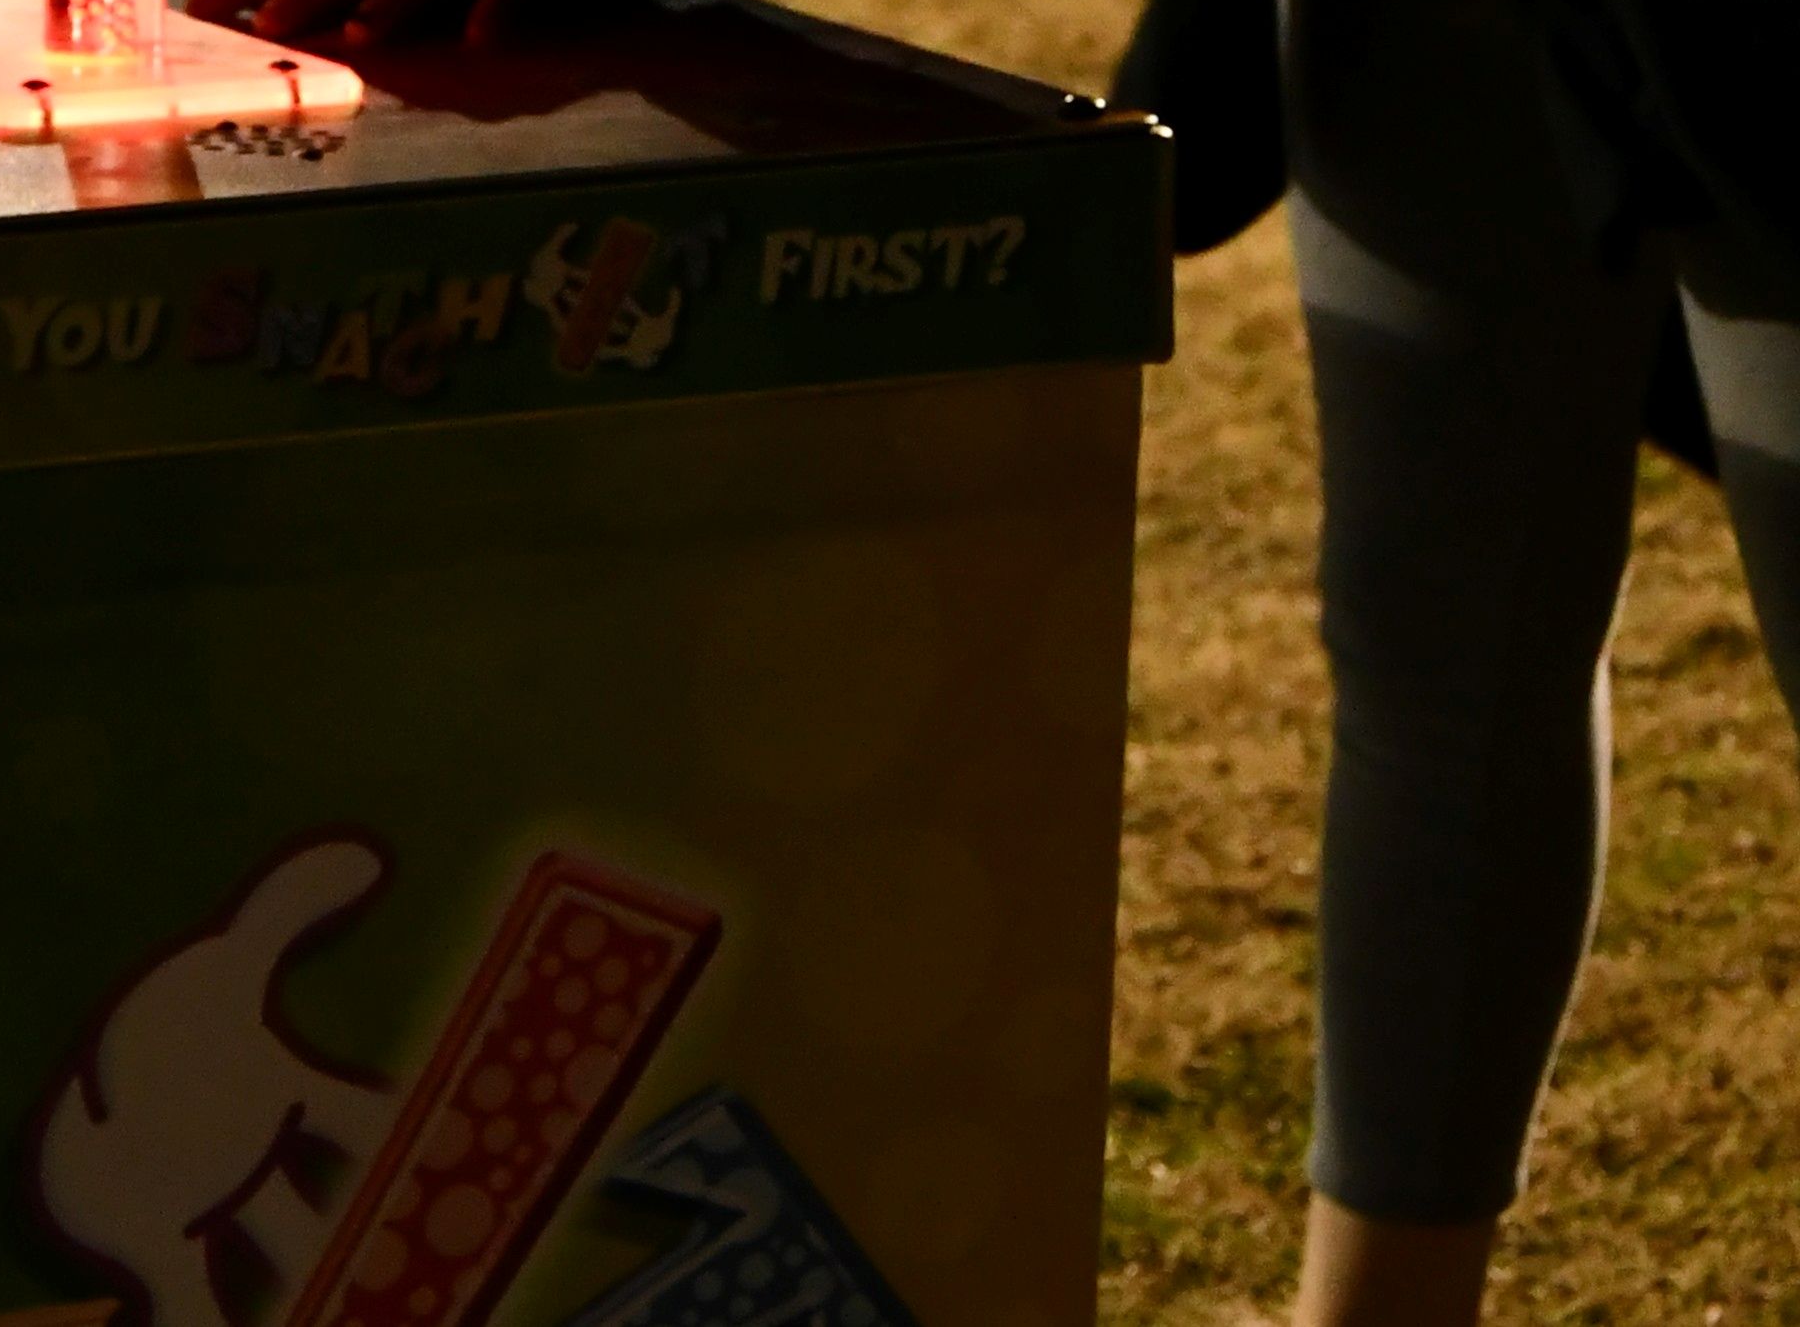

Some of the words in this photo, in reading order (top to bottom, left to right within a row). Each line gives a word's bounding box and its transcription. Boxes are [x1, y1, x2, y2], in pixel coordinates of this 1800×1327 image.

[1, 294, 165, 372] YOU
[184, 267, 514, 400] SNATCH
[760, 213, 1028, 306] FIRST?
